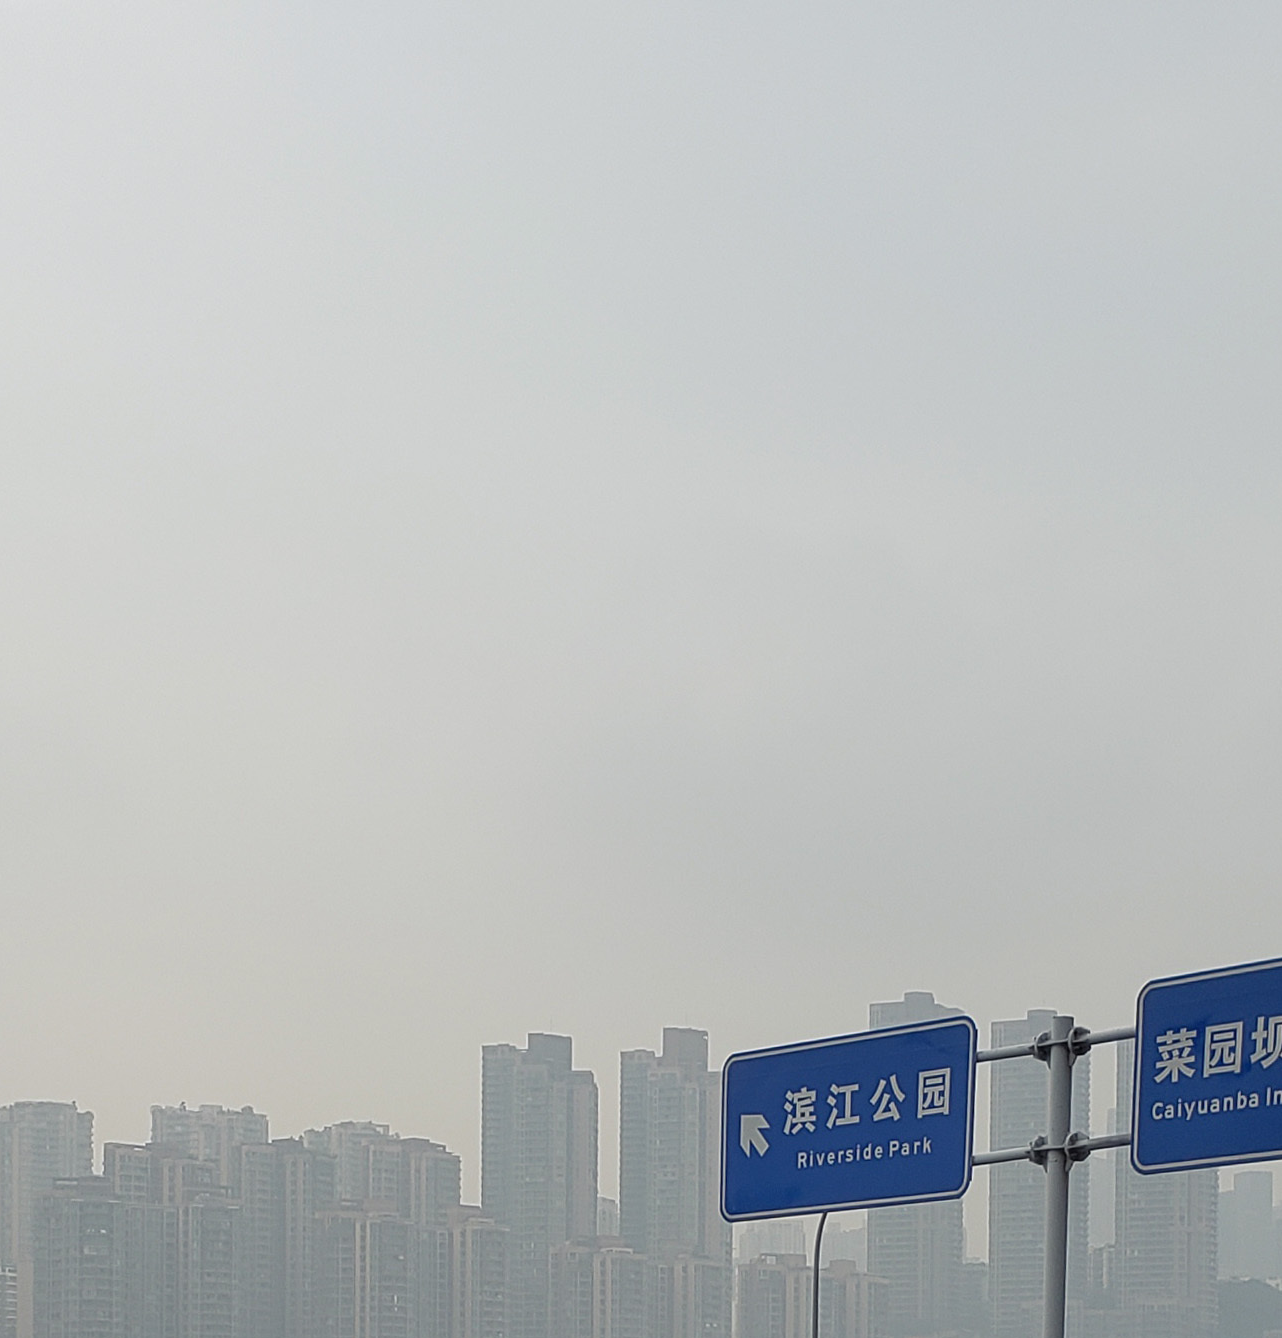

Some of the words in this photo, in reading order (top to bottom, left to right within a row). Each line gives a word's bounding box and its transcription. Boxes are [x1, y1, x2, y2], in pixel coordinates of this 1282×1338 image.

[783, 1067, 951, 1136] 滨江公园
[1151, 1091, 1260, 1121] Caiyuanba
[797, 1143, 884, 1169] Riverside
[889, 1136, 933, 1158] Park
